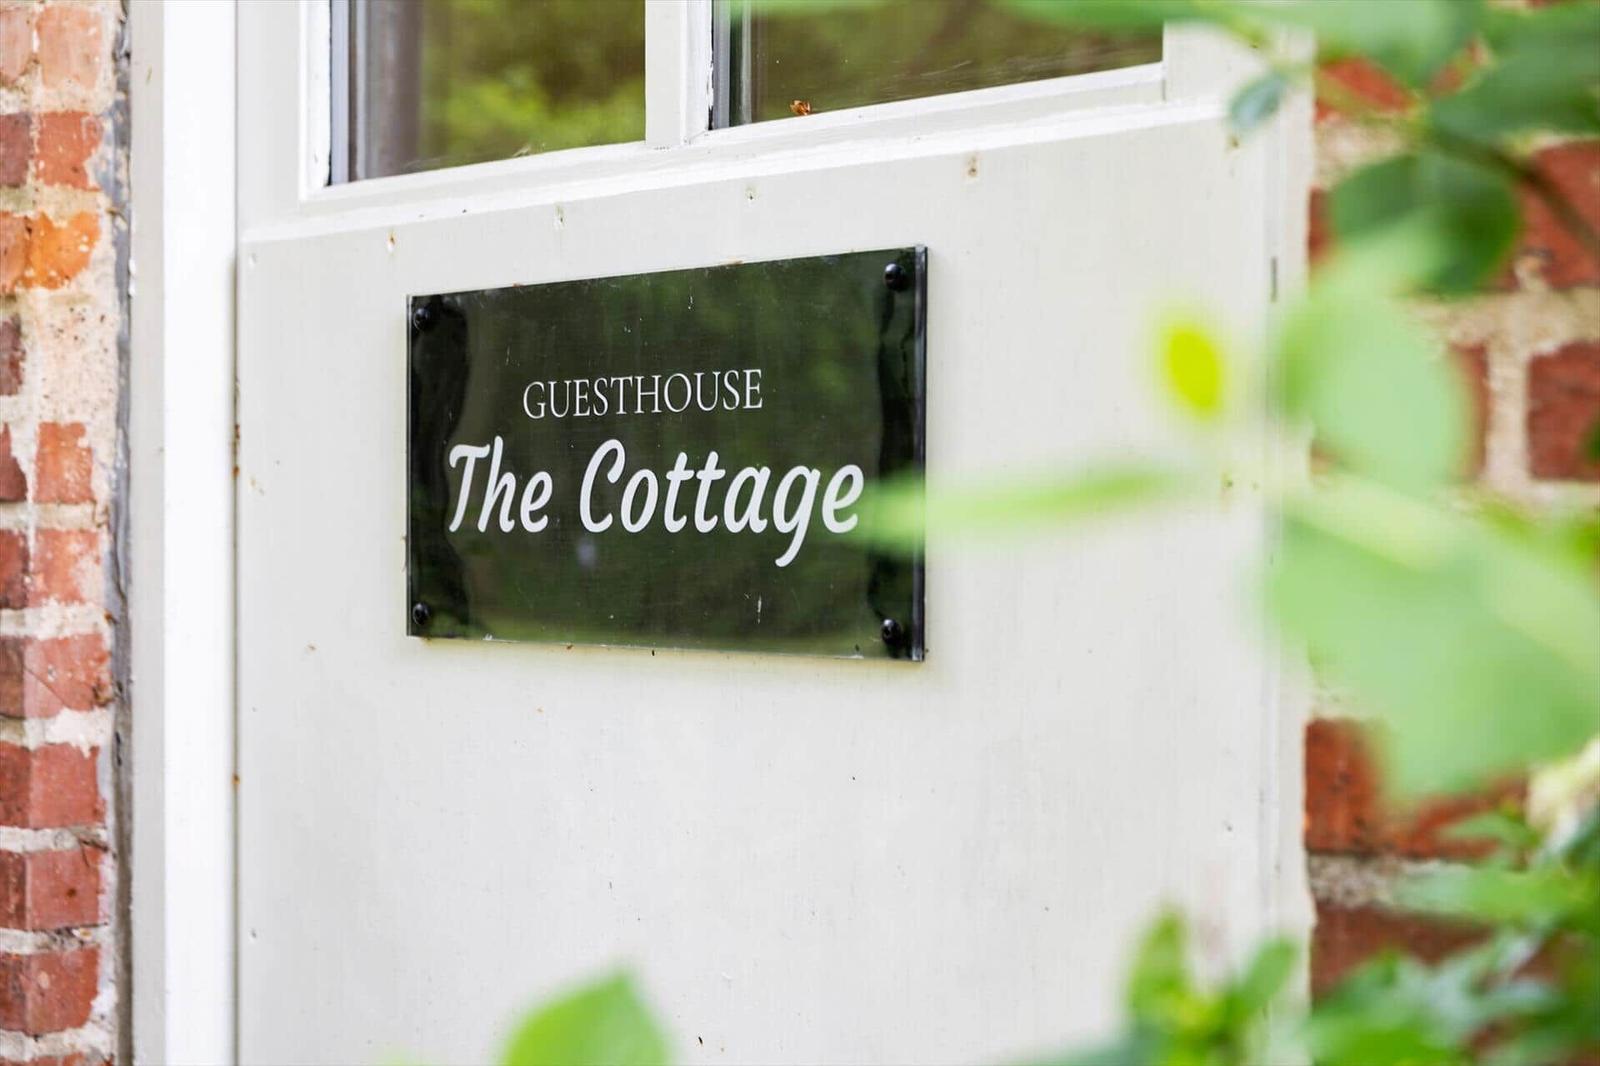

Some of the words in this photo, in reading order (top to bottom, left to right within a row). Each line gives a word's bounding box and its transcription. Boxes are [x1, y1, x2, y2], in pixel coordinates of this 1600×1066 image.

[522, 368, 764, 420] GUESTHOUSE
[449, 435, 553, 534] The
[578, 439, 864, 568] Cottage
